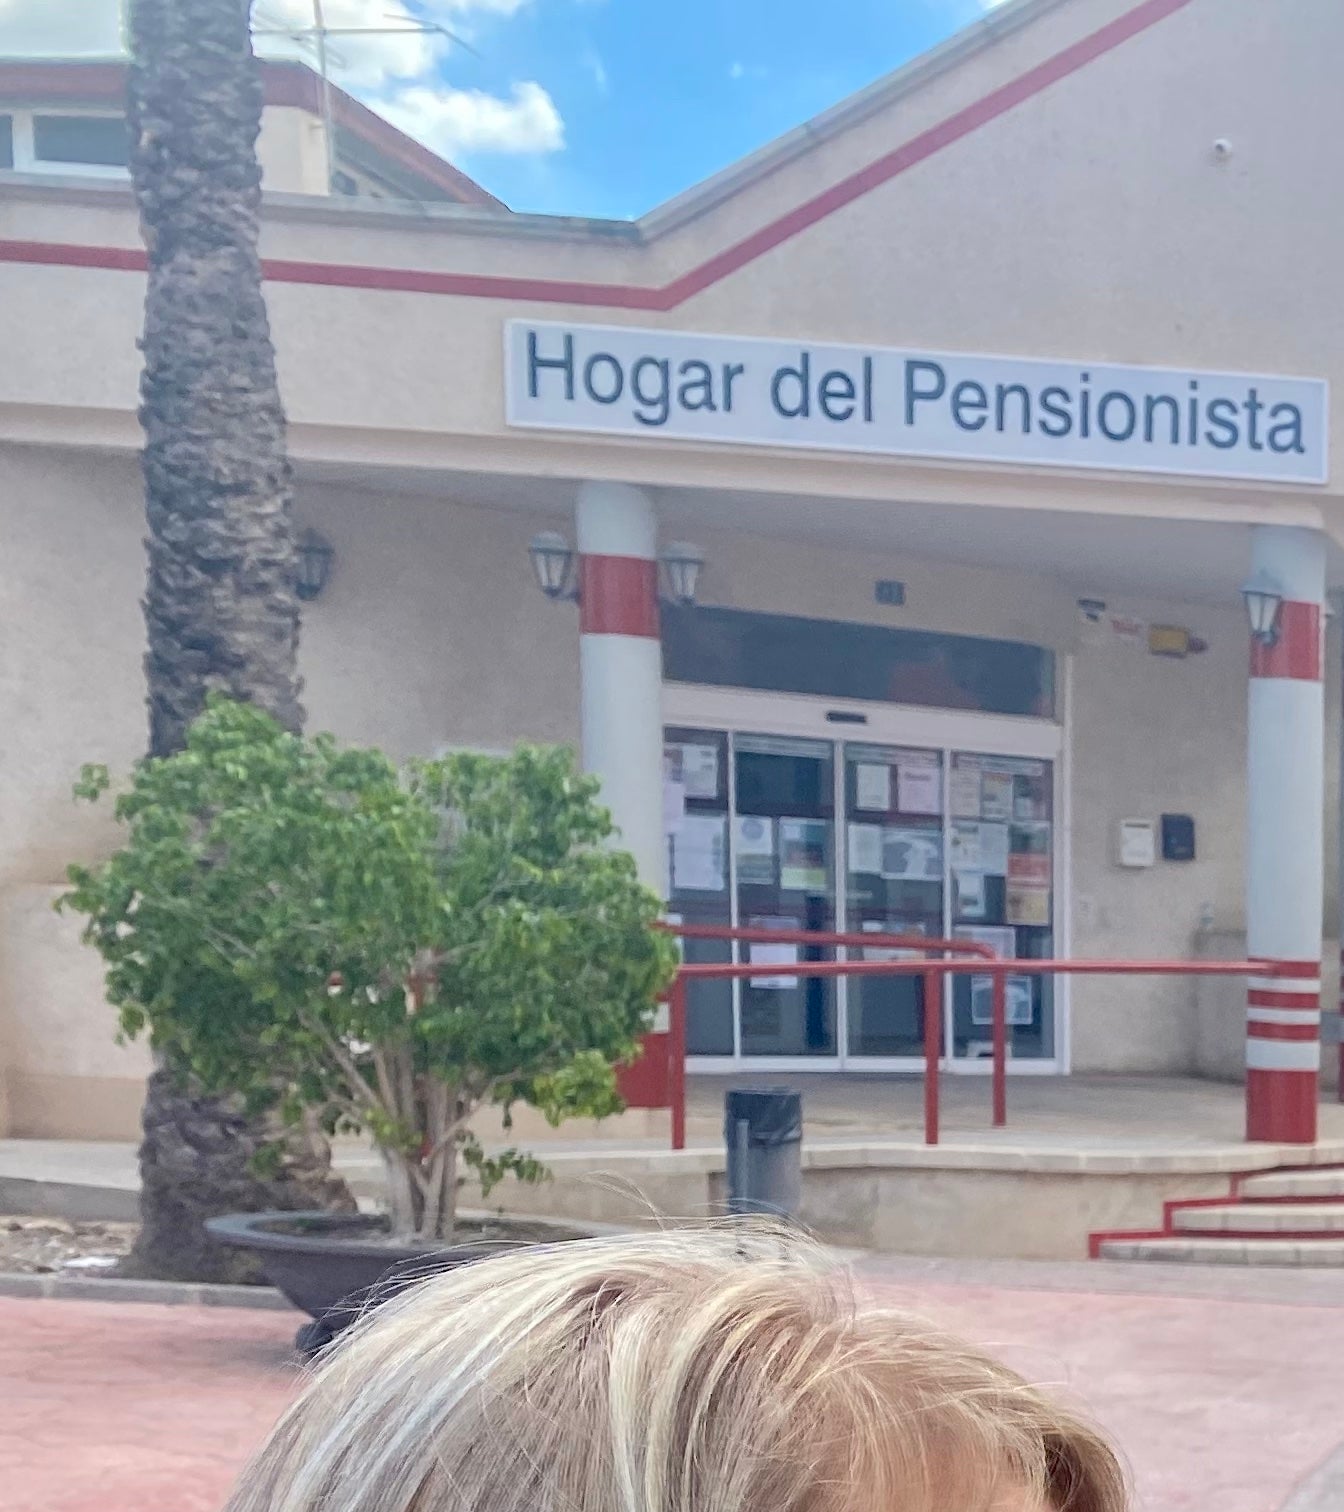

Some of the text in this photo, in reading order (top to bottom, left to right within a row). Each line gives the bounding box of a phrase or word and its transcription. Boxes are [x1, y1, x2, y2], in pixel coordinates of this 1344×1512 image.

[526, 330, 1306, 455] Hogar del Pensionista
